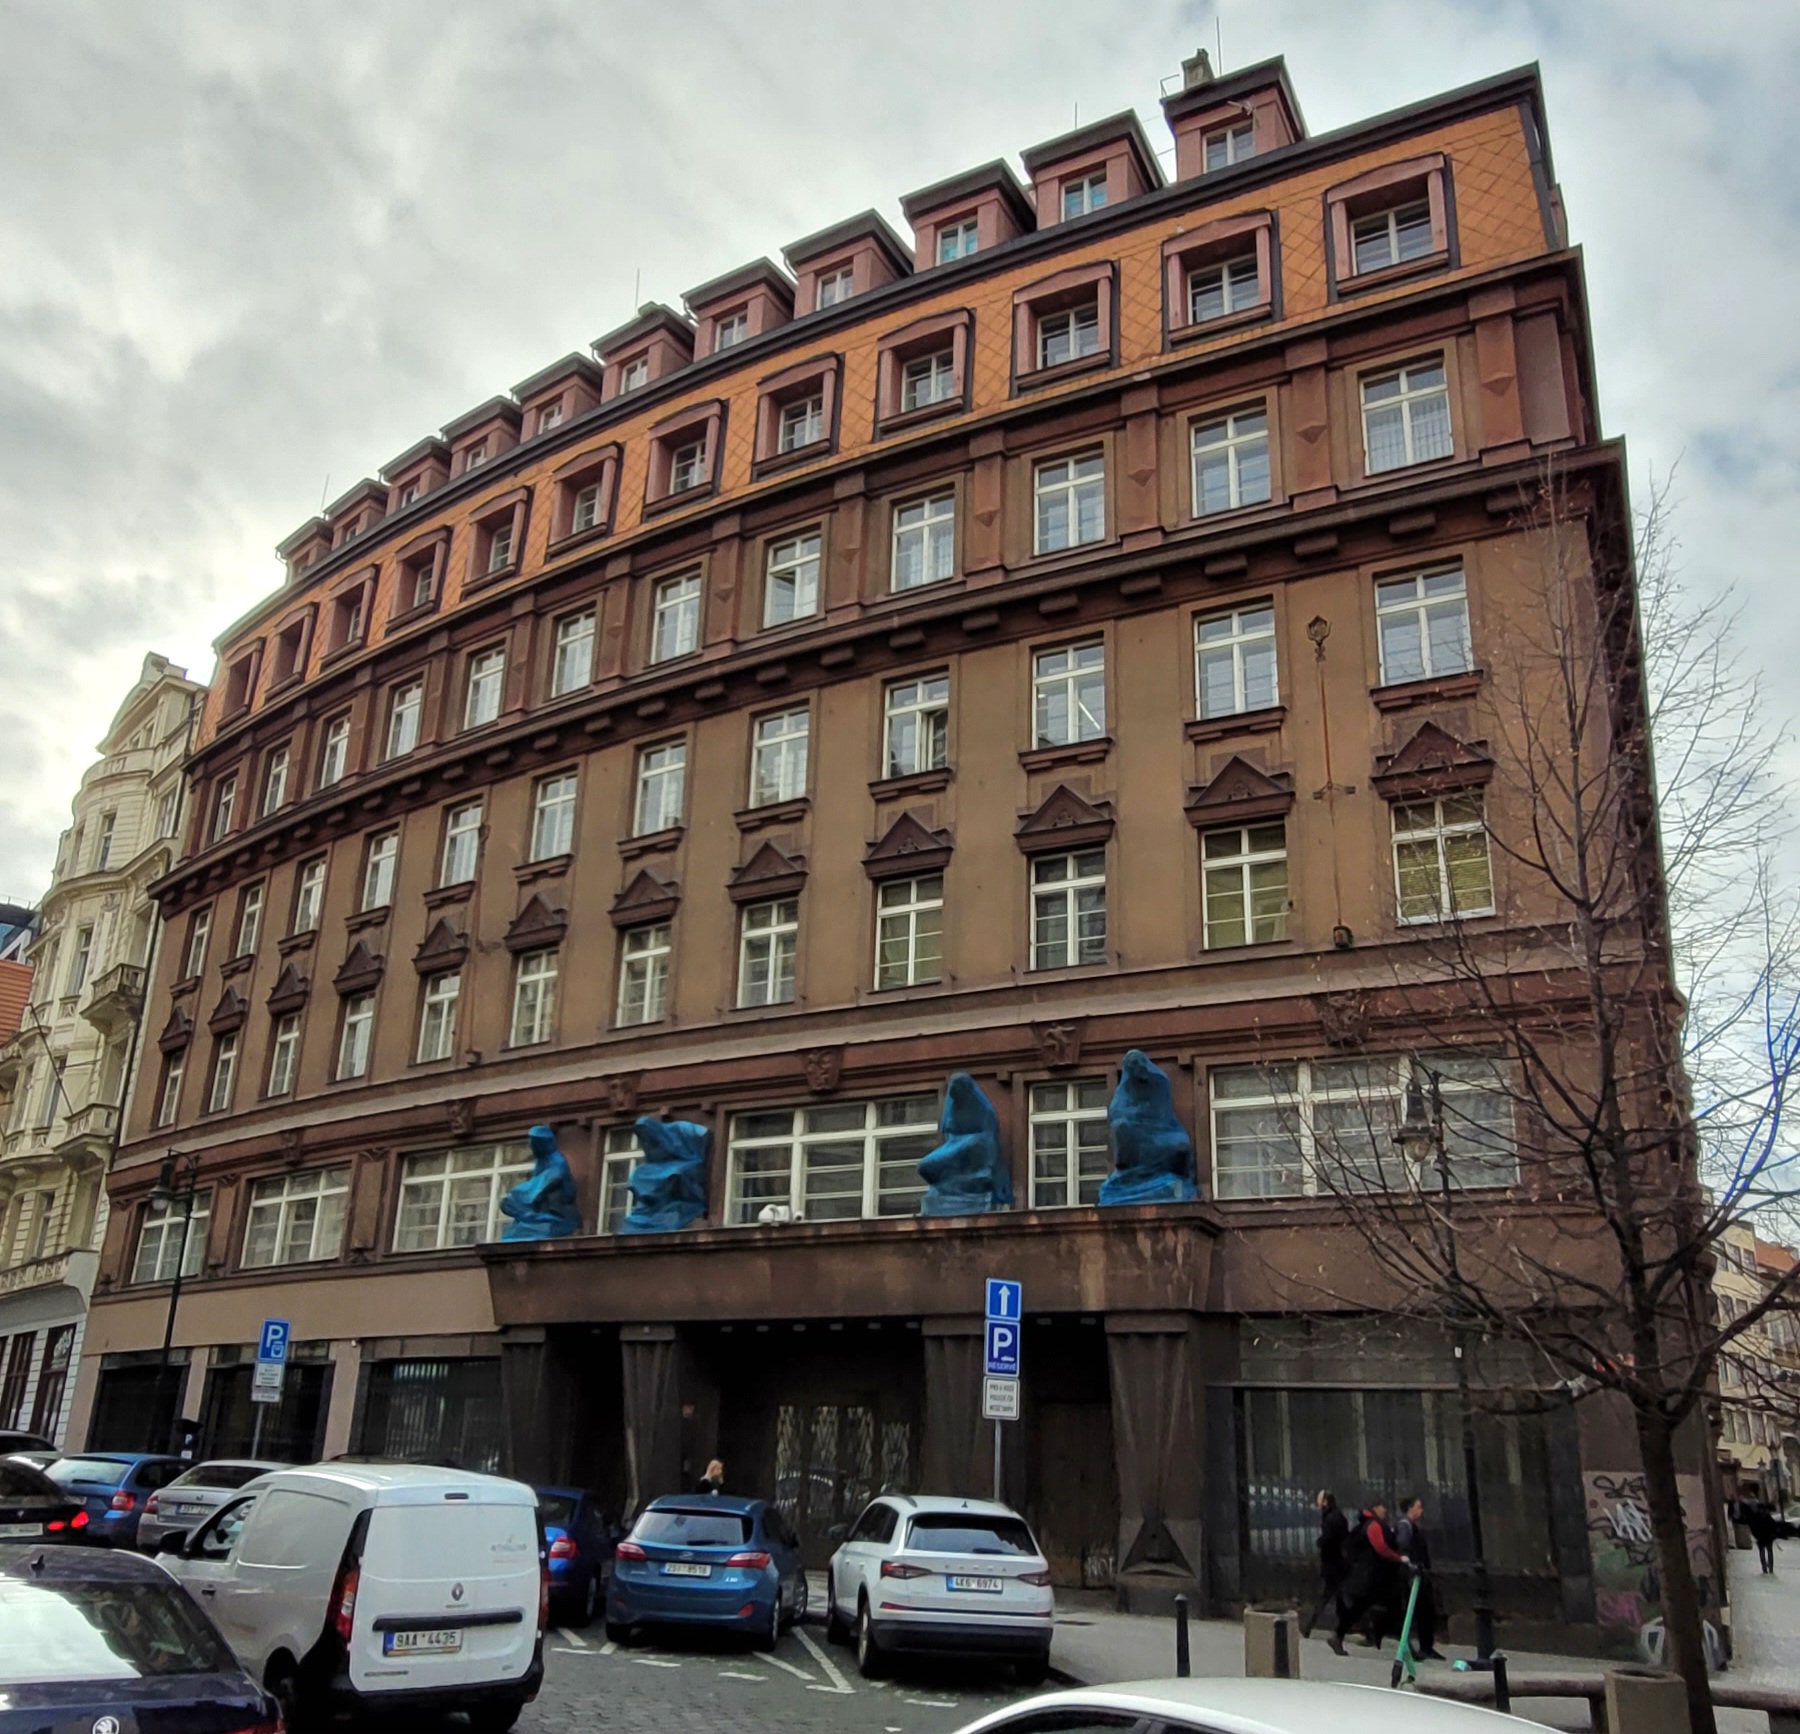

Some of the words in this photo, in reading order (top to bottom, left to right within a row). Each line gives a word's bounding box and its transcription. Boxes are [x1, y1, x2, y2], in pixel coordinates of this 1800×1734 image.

[265, 1324, 284, 1348] P
[993, 1327, 1013, 1359] P
[396, 1634, 417, 1647] 9AA
[427, 1631, 457, 1645] 4435
